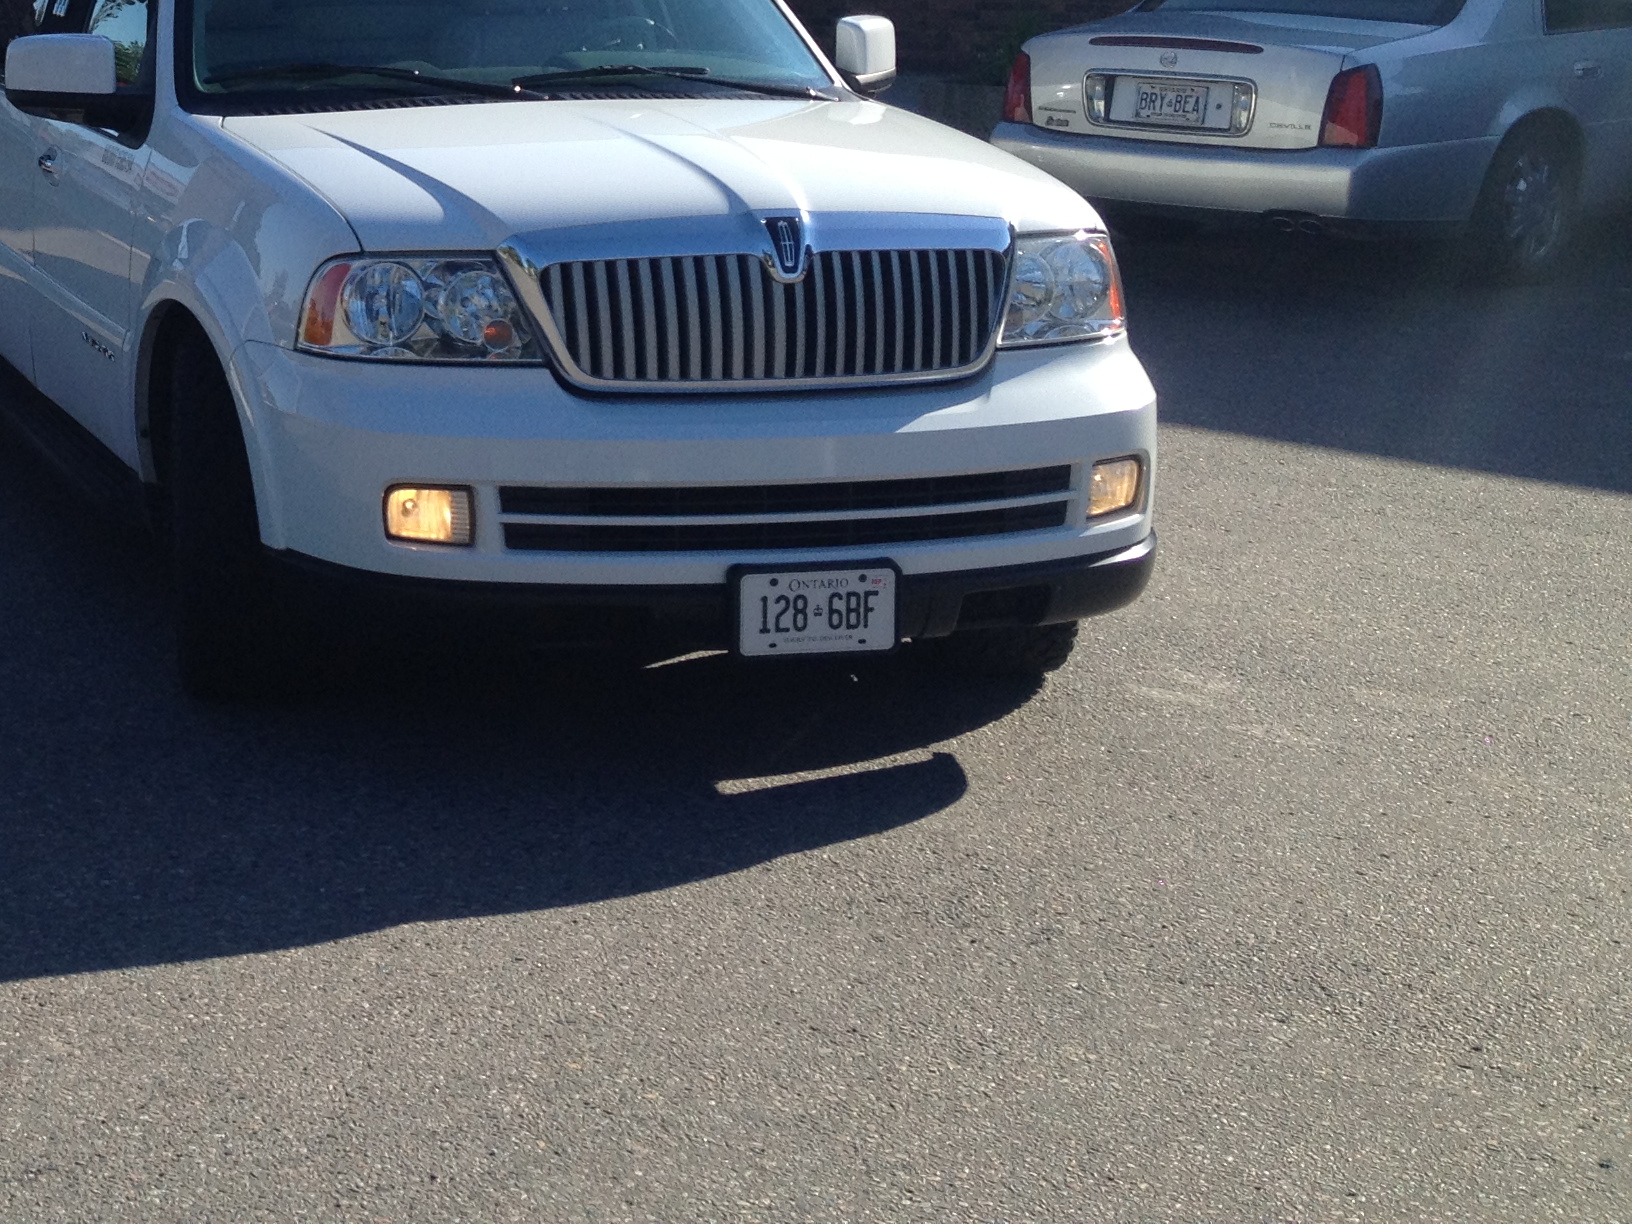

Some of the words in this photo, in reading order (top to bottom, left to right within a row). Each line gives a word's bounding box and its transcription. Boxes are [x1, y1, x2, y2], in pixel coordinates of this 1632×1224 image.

[1138, 91, 1167, 112] BRY
[1173, 94, 1201, 114] BEA
[788, 577, 849, 592] ONTARIO
[758, 593, 808, 634] 128
[827, 590, 880, 631] 6BF
